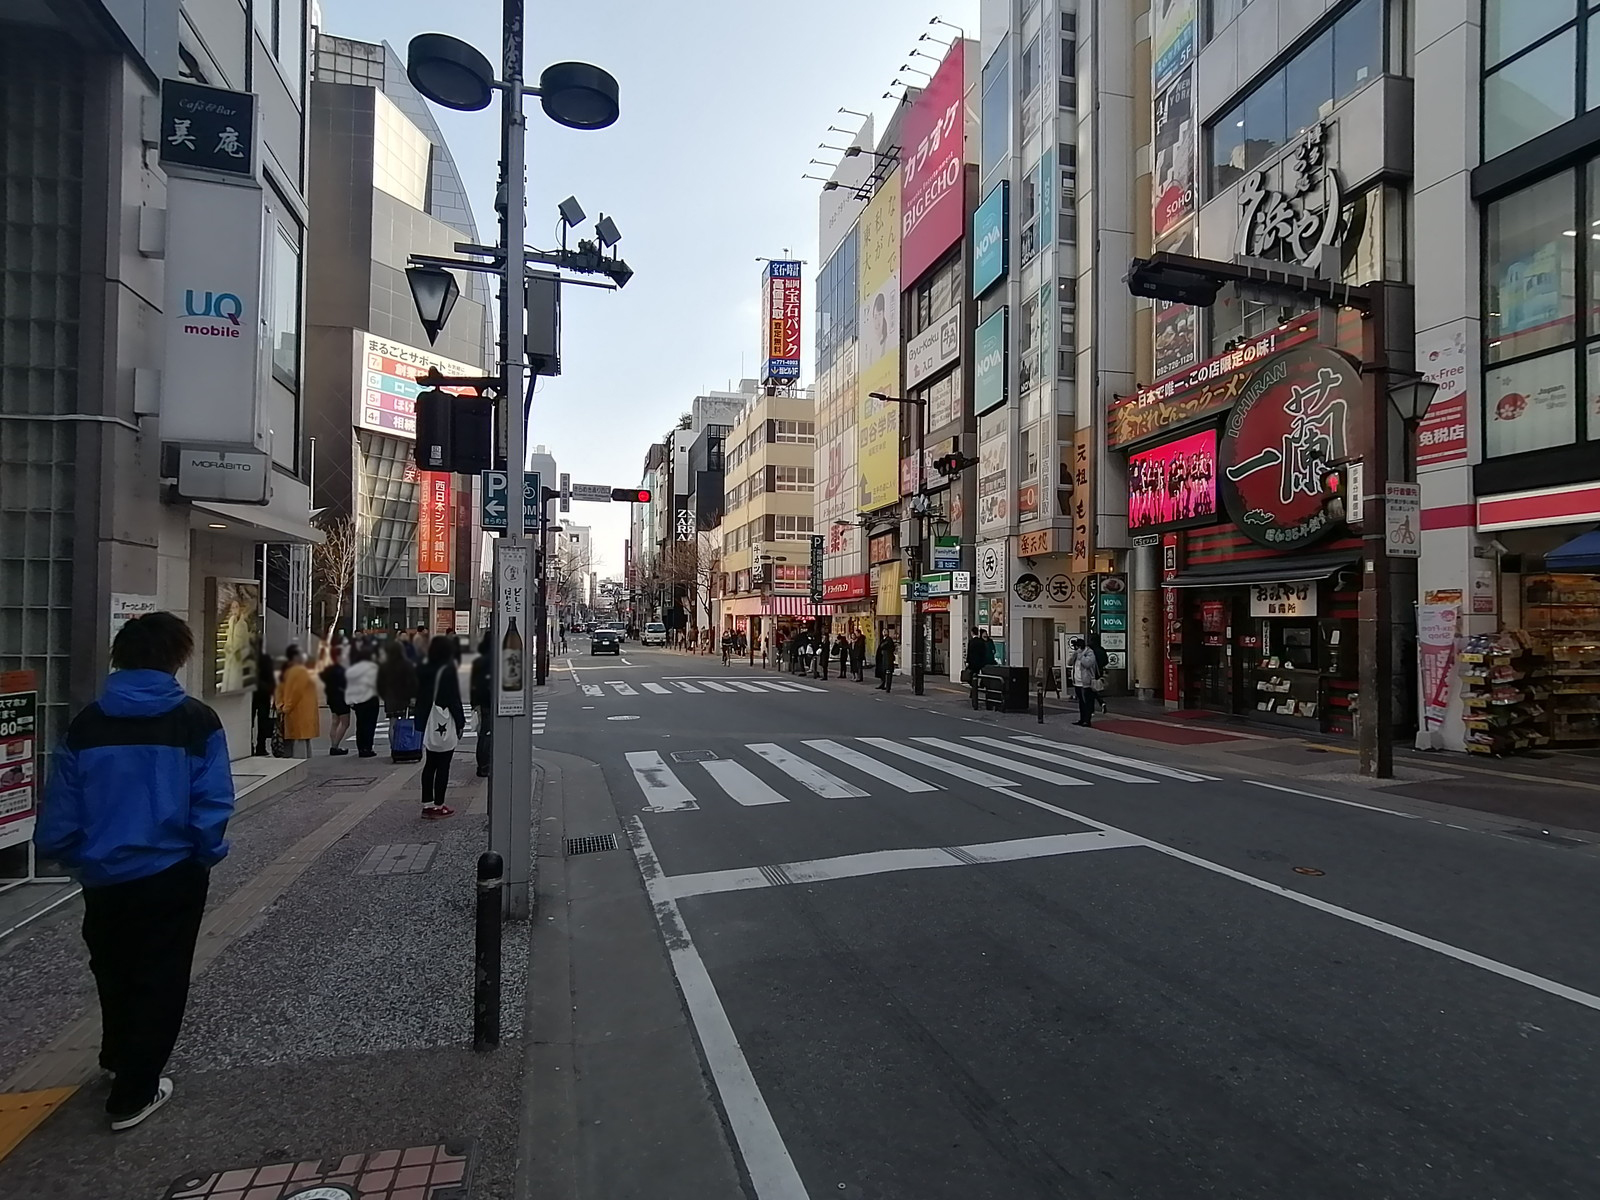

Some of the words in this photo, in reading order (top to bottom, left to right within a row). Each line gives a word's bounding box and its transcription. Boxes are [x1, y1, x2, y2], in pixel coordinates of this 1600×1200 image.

[1180, 43, 1192, 66] 5F
[1169, 89, 1190, 106] YORK
[1175, 78, 1191, 93] NEW
[216, 105, 236, 115] Bar
[903, 99, 960, 189] カラオケ
[903, 198, 924, 240] BIG
[925, 156, 960, 207] ECHO
[1165, 189, 1192, 217] SOHO
[1253, 190, 1320, 260] 浜や
[976, 225, 1001, 260] NOVA
[185, 289, 243, 326] UQ
[184, 325, 241, 338] mobile
[785, 288, 799, 358] 宝石バンク
[368, 340, 446, 371] まるごとサポート
[909, 332, 939, 361] Gyu-Kaku
[922, 356, 933, 373] 入口
[977, 349, 1003, 378] NOVA
[1422, 365, 1465, 382] ax-Free
[1228, 361, 1287, 438] ICHIRAN
[861, 409, 897, 449] 四谷学院
[1226, 367, 1348, 504] 一蘭
[1419, 424, 1465, 447] 免税店
[192, 460, 251, 472] MORABITO
[1075, 445, 1088, 487] 元祖
[488, 473, 507, 498] P
[1386, 487, 1418, 497] 歩行者優先
[434, 480, 446, 563] 西日本シティ銀行
[676, 509, 687, 542] ZARA
[1074, 498, 1088, 561] もつ鍋
[814, 537, 821, 547] P
[1020, 533, 1049, 555] 楽天地
[985, 555, 995, 572] 天
[1052, 580, 1069, 596] 天
[1256, 584, 1310, 602] おみやげ
[1103, 597, 1122, 606] NOVA
[1268, 603, 1296, 614] 販売所
[1103, 618, 1123, 627] NOVA
